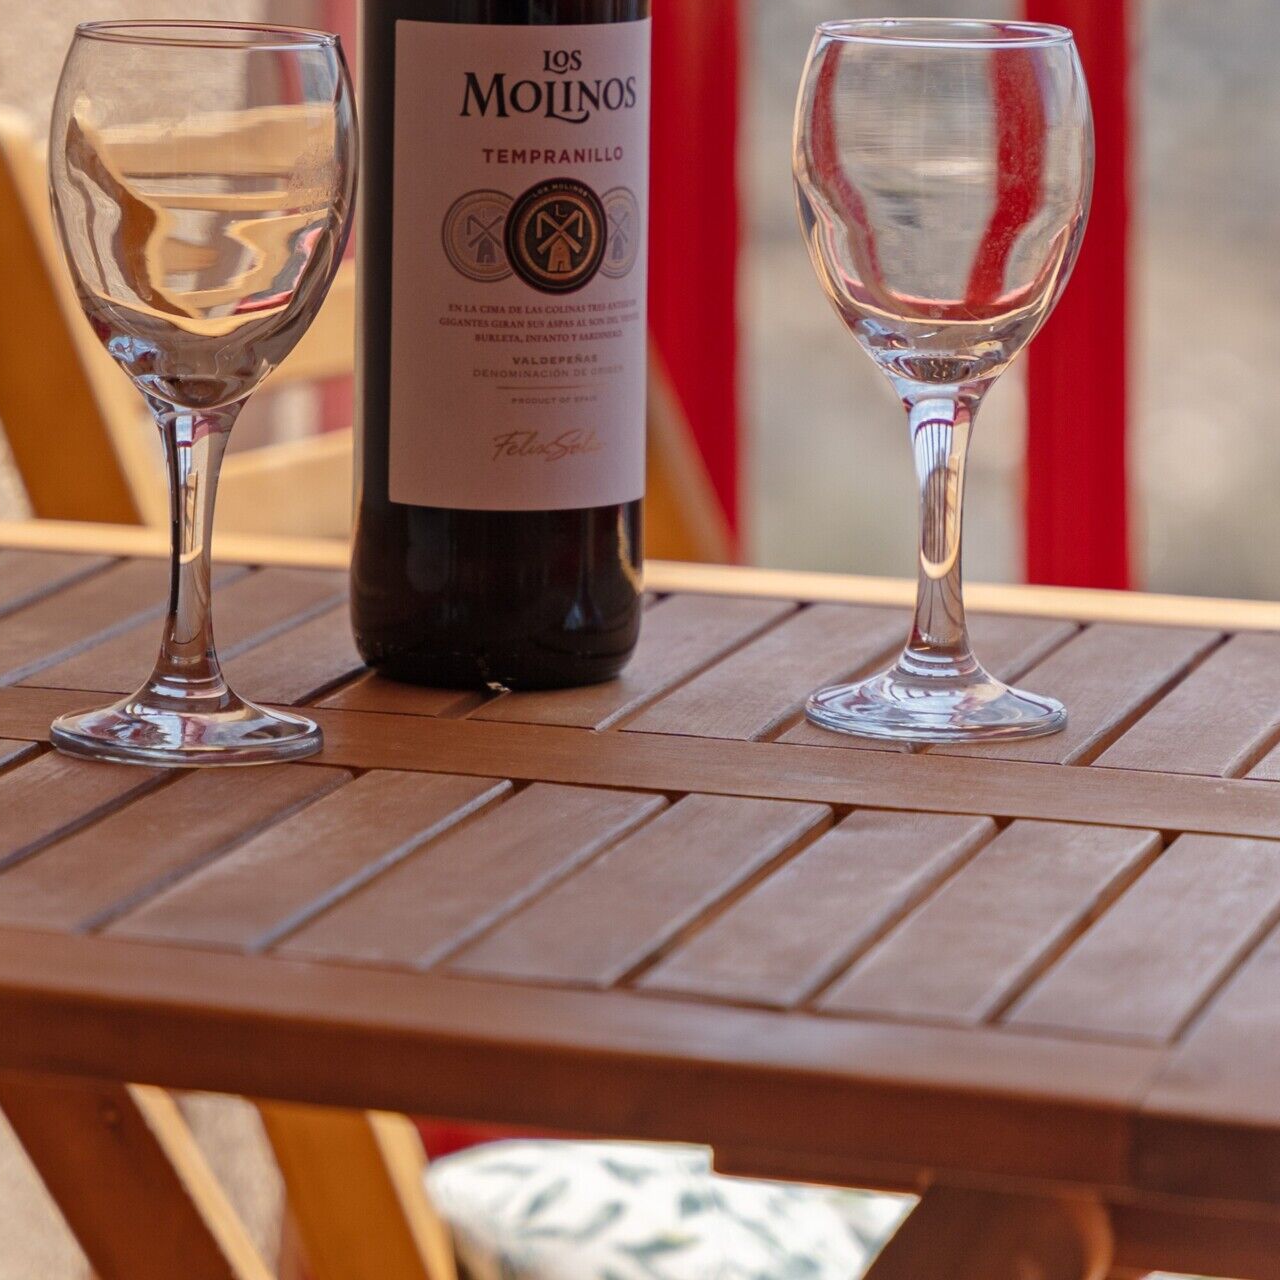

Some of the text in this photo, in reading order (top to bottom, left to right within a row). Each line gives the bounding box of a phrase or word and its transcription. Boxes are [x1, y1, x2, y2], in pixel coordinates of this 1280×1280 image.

[543, 49, 582, 74] LOS
[460, 72, 637, 124] MOLINOS
[482, 146, 624, 164] TEMPRANILLO
[448, 303, 463, 313] EN
[464, 304, 478, 313] LA
[508, 305, 523, 314] DE
[525, 304, 544, 314] LAS
[439, 317, 489, 328] GIGANTES
[491, 318, 524, 329] GIRAN
[512, 353, 599, 366] VALDEPEÑAS
[472, 367, 569, 379] DENOMINACIÓN
